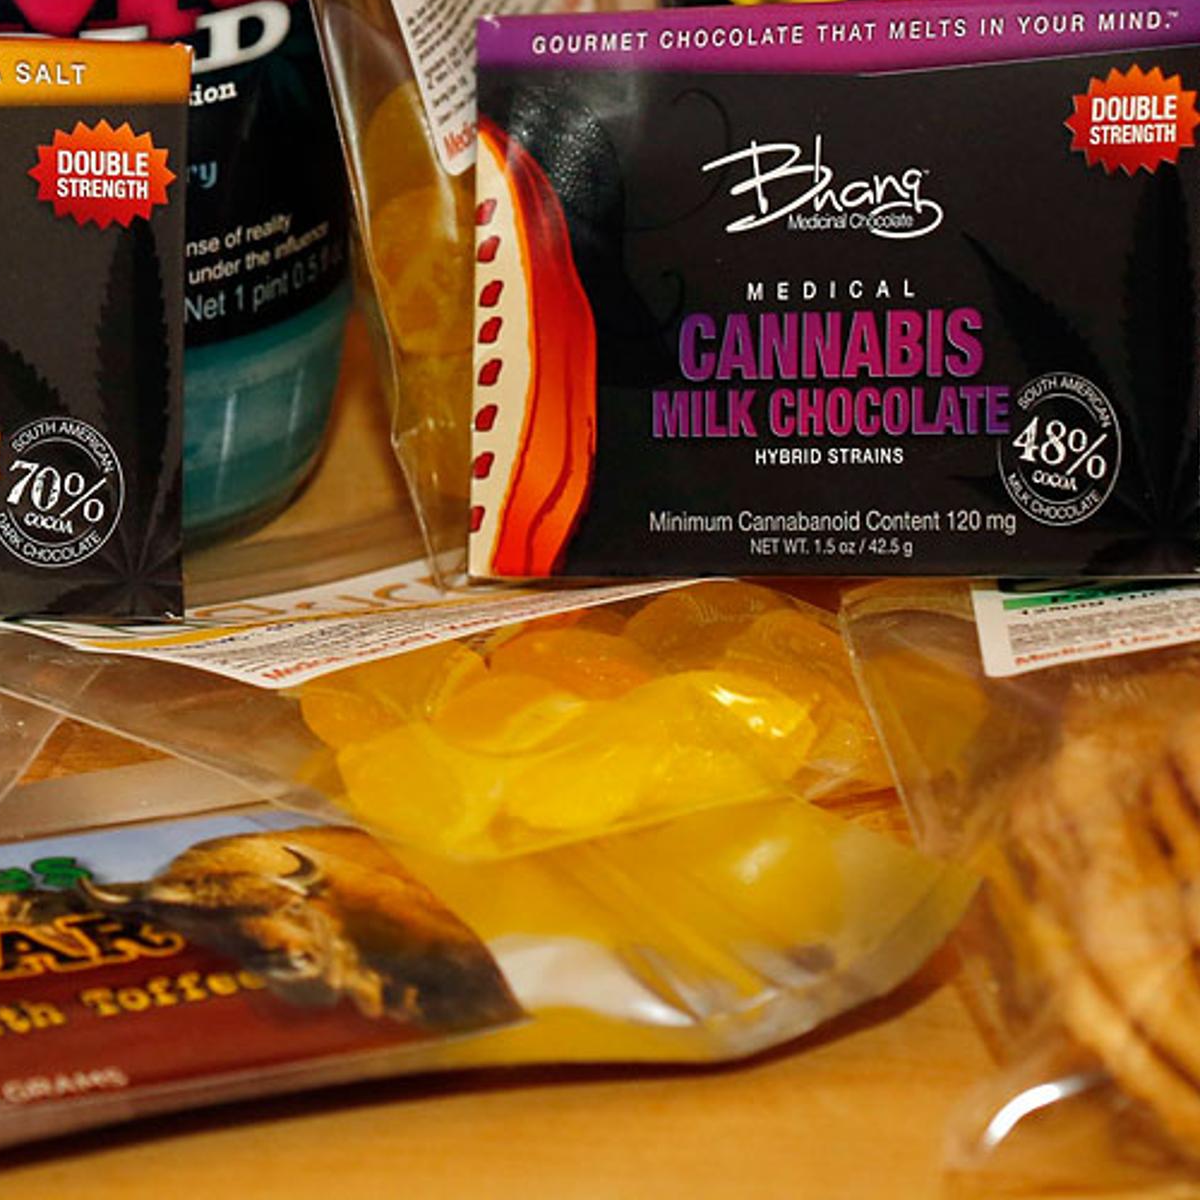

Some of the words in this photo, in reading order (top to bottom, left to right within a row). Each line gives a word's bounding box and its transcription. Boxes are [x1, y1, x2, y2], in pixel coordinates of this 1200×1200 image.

[531, 31, 649, 55] GOURMET
[659, 25, 805, 49] CHOCOLATE
[816, 22, 877, 43] THAT
[888, 18, 968, 40] MELTS
[979, 17, 1005, 36] IN
[1016, 13, 1086, 34] YOUR
[14, 63, 88, 86] SALT
[1090, 95, 1178, 123] DOUBLE
[1089, 123, 1177, 146] STRENGTH
[56, 149, 150, 178] DOUBLE
[56, 177, 150, 201] STRENGTH
[701, 133, 944, 239] Bhang
[224, 224, 242, 248] of
[787, 212, 848, 231] Medicinal
[849, 213, 914, 230] Chocolate
[188, 257, 241, 285] under
[244, 249, 270, 271] the
[183, 293, 226, 324] Net
[235, 284, 245, 312] 1
[252, 268, 289, 313] pint
[746, 278, 917, 301] MEDICAL
[678, 306, 985, 382] CANNABIS
[651, 388, 758, 439] MILK
[768, 384, 1012, 438] CHOCOLATE
[1017, 376, 1058, 410] SOUTH
[1059, 376, 1112, 428] AMERICAN
[10, 421, 57, 453] SOUTH
[58, 421, 116, 474] AMERICAN
[754, 447, 822, 465] HYBRID
[826, 446, 905, 465] STRAINS
[1011, 415, 1108, 480] 48%
[5, 459, 108, 523] 70%
[1028, 489, 1101, 520] CHOCOLATE
[23, 511, 74, 535] COCOA
[648, 511, 734, 533] Minimum
[737, 511, 862, 533] Cannabanoid
[865, 511, 941, 532] Content
[946, 511, 982, 531] 120
[985, 515, 1018, 538] mg
[22, 530, 103, 562] CHOCOLATE
[749, 538, 780, 555] NET
[782, 538, 810, 555] WT.
[814, 538, 836, 555] 1.5
[838, 542, 857, 555] oz
[868, 538, 900, 555] 42.5
[902, 542, 914, 559] g
[81, 969, 267, 1018] Toffee
[0, 1066, 130, 1106] GRAMS
